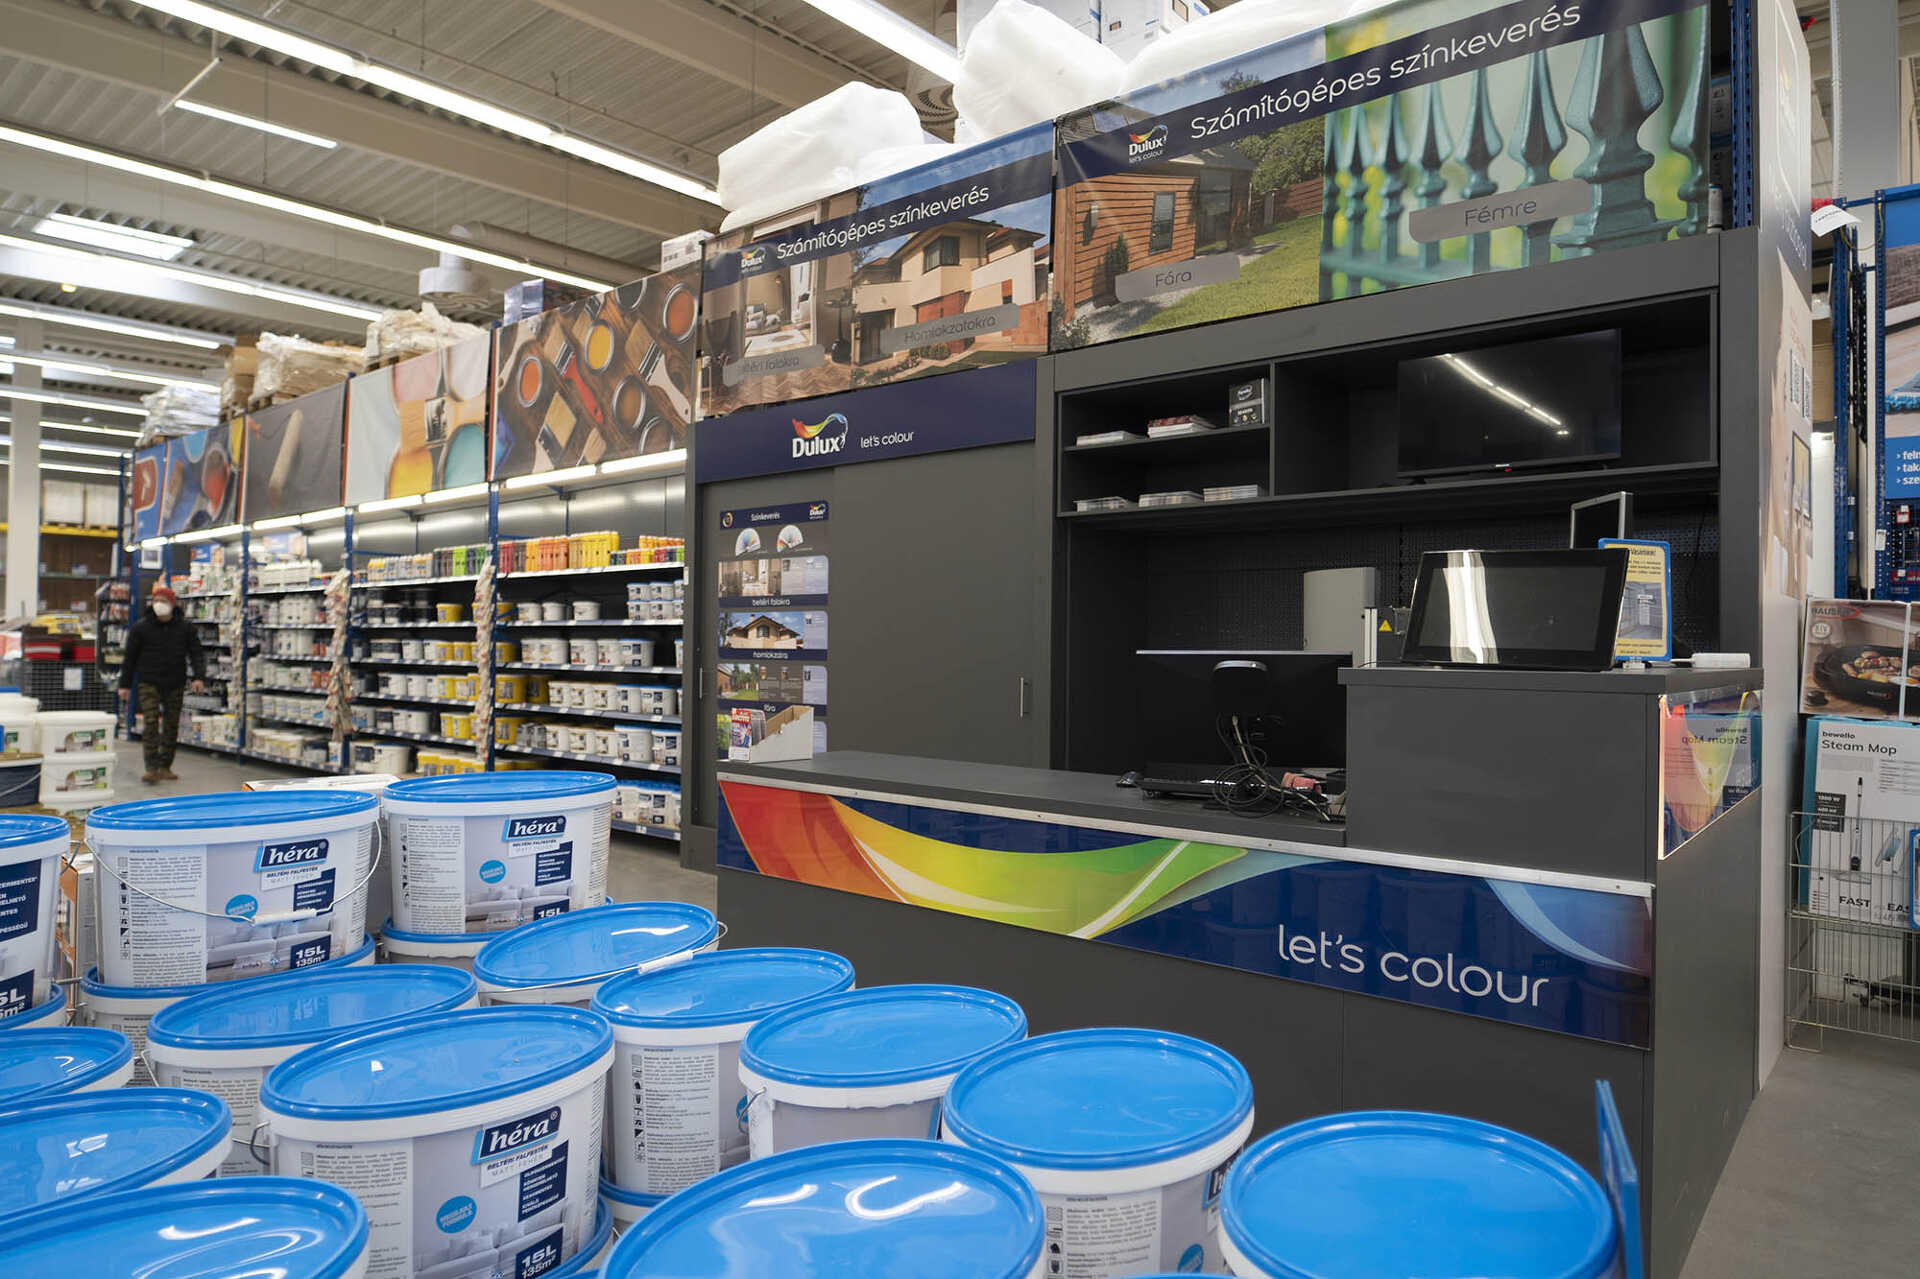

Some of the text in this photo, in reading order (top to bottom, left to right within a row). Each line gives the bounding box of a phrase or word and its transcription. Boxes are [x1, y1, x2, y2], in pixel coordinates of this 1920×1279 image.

[1190, 4, 1581, 139] Számítógépes színkeverés
[1128, 137, 1164, 156] Dulux
[776, 185, 990, 260] Számítógépes színkeverés
[1464, 200, 1537, 226] Fémre
[741, 256, 763, 268] Dulux
[1155, 269, 1192, 288] Fára
[792, 436, 840, 458] Dulux
[860, 432, 914, 449] let's colour
[1822, 731, 1856, 739] bewello
[1821, 740, 1897, 756] Steam Mop
[513, 820, 557, 836] héra
[268, 845, 319, 865] héra
[1839, 895, 1871, 908] FAST
[295, 945, 326, 959] 15L
[1277, 923, 1550, 1007] let's colour
[489, 1118, 549, 1152] héra
[521, 1245, 557, 1268] 15L
